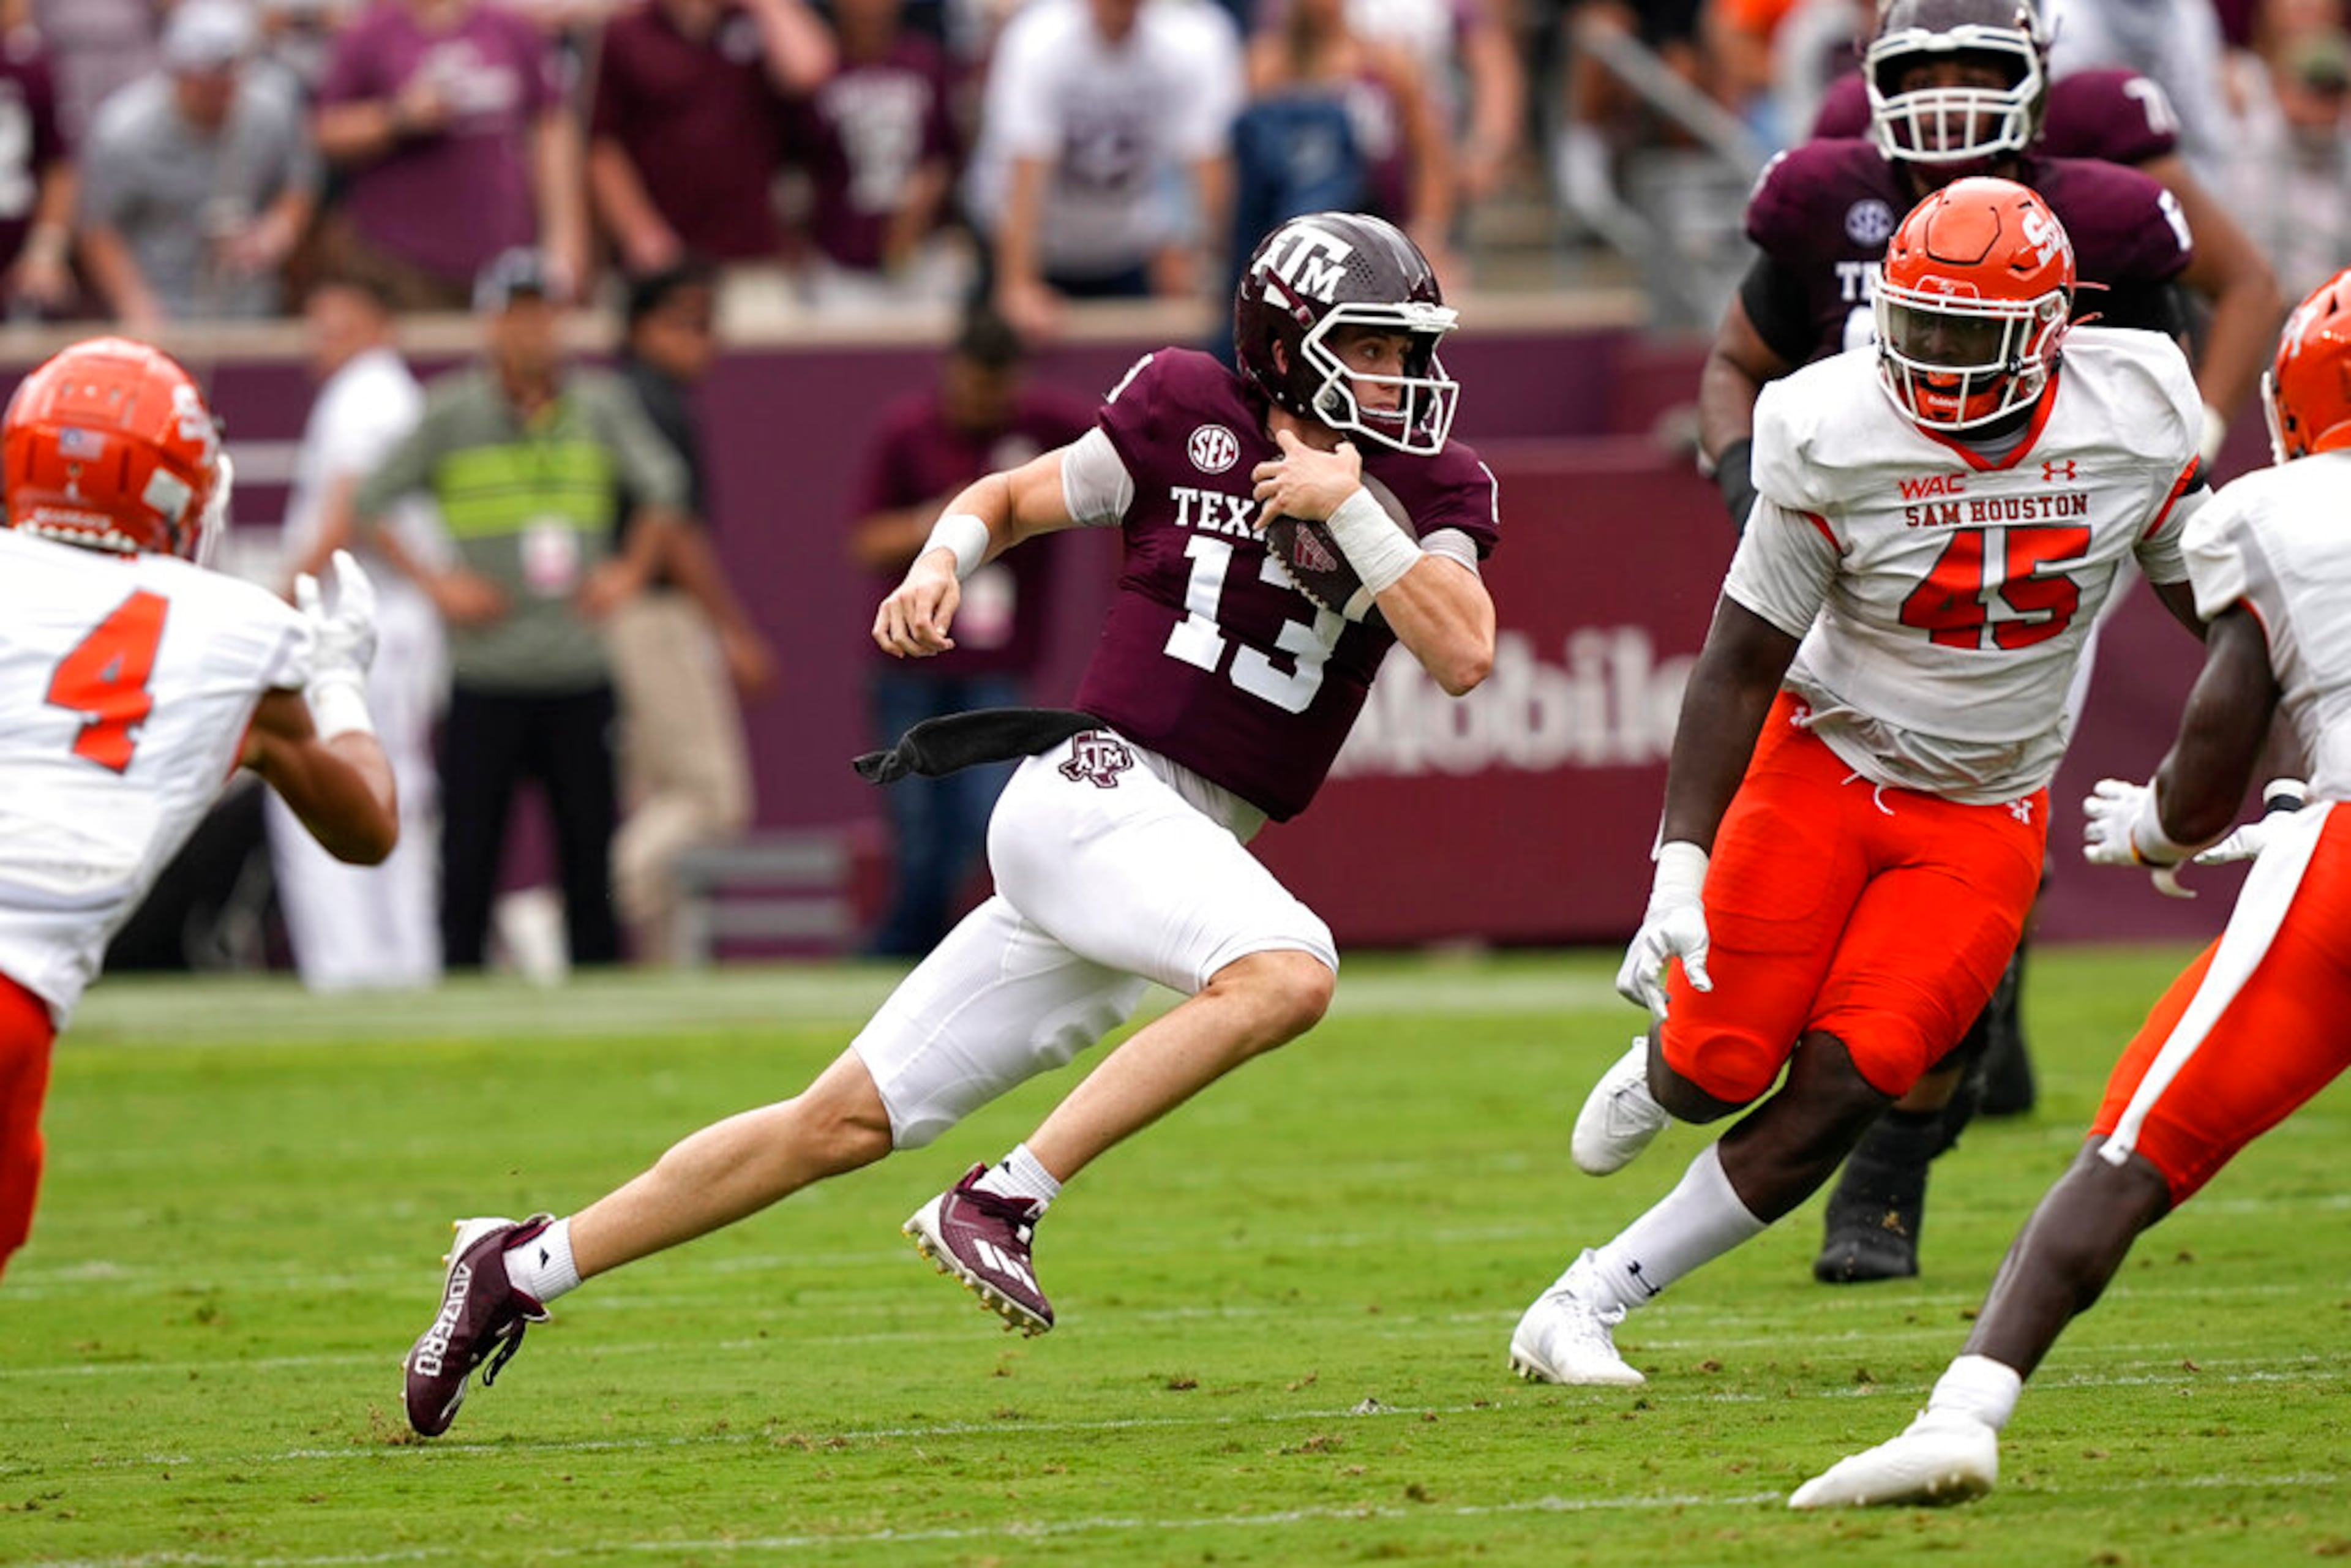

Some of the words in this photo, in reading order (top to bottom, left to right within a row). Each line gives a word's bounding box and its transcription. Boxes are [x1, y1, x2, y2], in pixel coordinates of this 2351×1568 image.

[1190, 426, 1238, 472] SEC
[1898, 472, 1967, 500] WAC
[1170, 486, 1266, 541] TEX
[1905, 503, 1961, 527] SAM
[1970, 493, 2088, 522] HOUSTON
[1163, 534, 1347, 715] 13
[1899, 525, 2091, 650] 45
[46, 587, 170, 775] 4
[414, 1262, 472, 1377] ADIZERO
